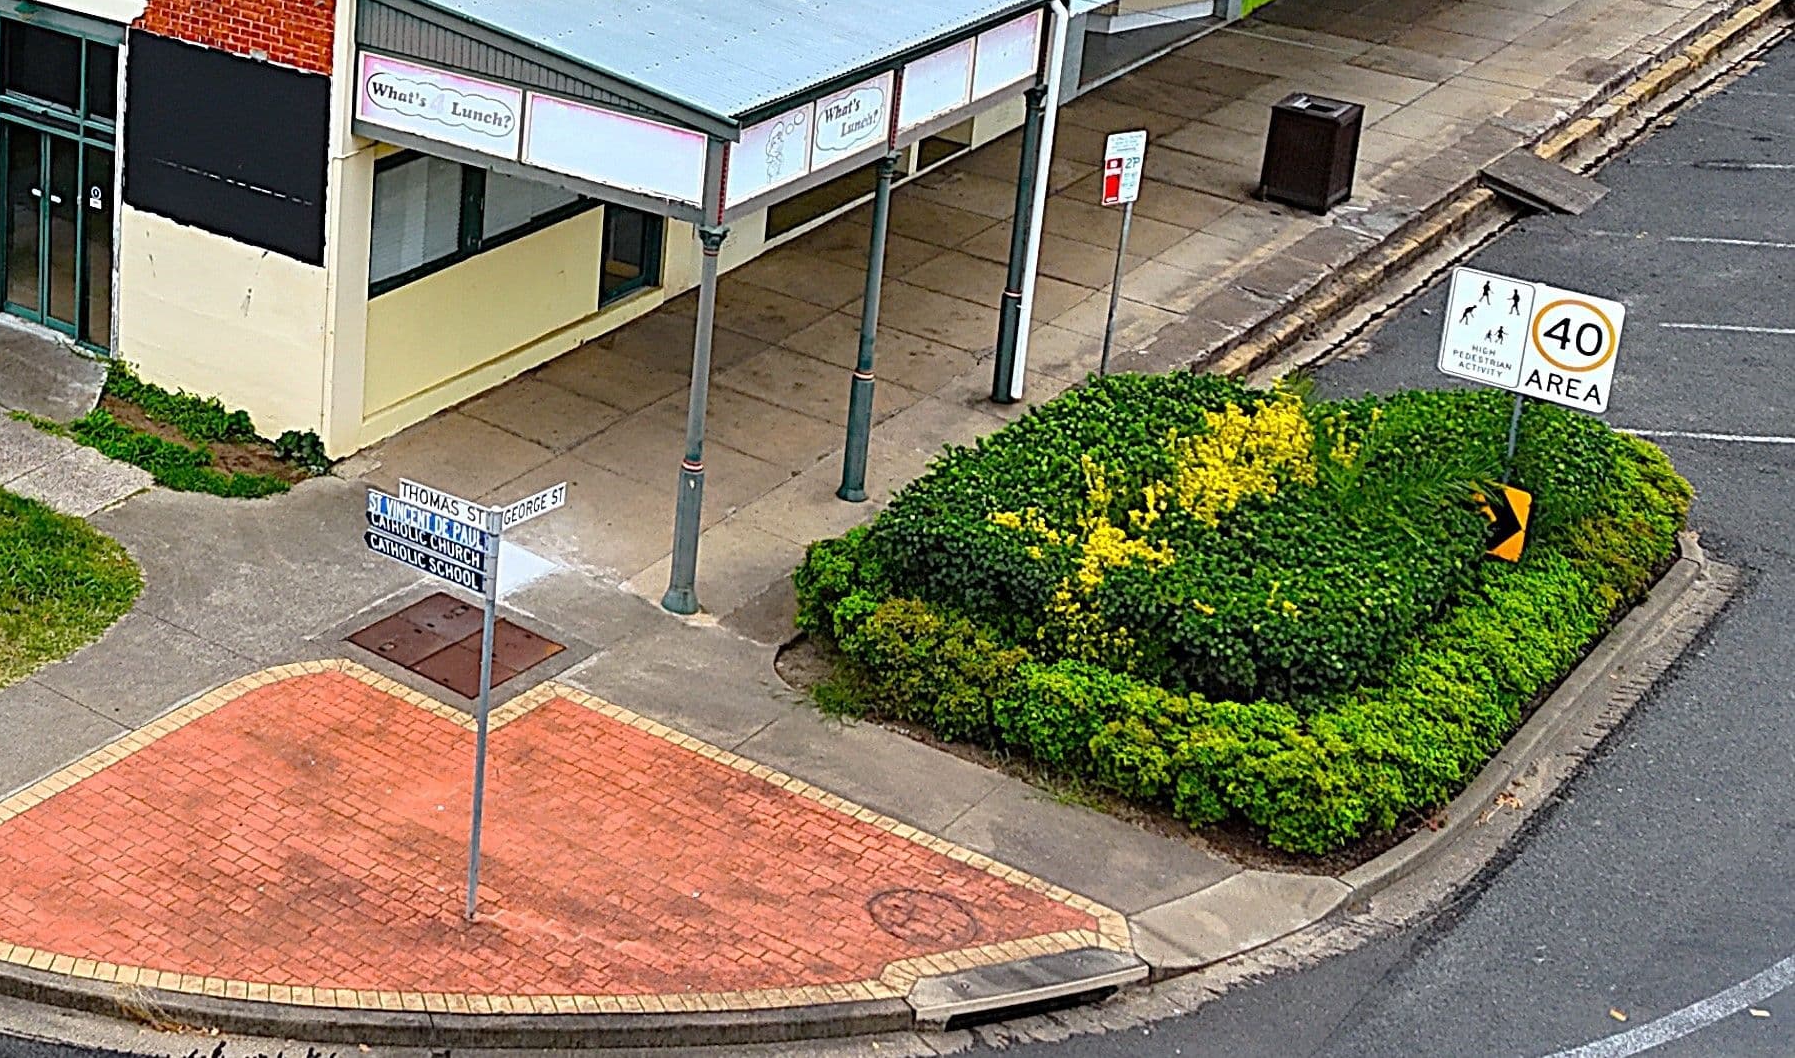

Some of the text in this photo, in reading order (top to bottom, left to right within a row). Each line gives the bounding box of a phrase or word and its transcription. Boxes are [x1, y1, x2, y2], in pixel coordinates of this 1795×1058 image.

[372, 81, 427, 108] What's
[451, 101, 512, 129] Lunch?
[825, 98, 861, 123] What's
[840, 109, 879, 137] Lunch?
[1125, 157, 1141, 169] 2P
[1472, 345, 1496, 356] HIGH
[1543, 317, 1603, 357] 40
[1453, 349, 1512, 370] PEDESTRIAN
[1458, 361, 1503, 378] ACTIVITY
[1524, 368, 1602, 405] AREA
[368, 492, 485, 551] ST VINCENT DE PAUL
[401, 481, 486, 524] THOMAS ST
[504, 485, 566, 525] GEORGE ST
[371, 513, 480, 568] CATHOLIC CHURCH
[370, 534, 479, 590] CATHOLIC SCHOOL
